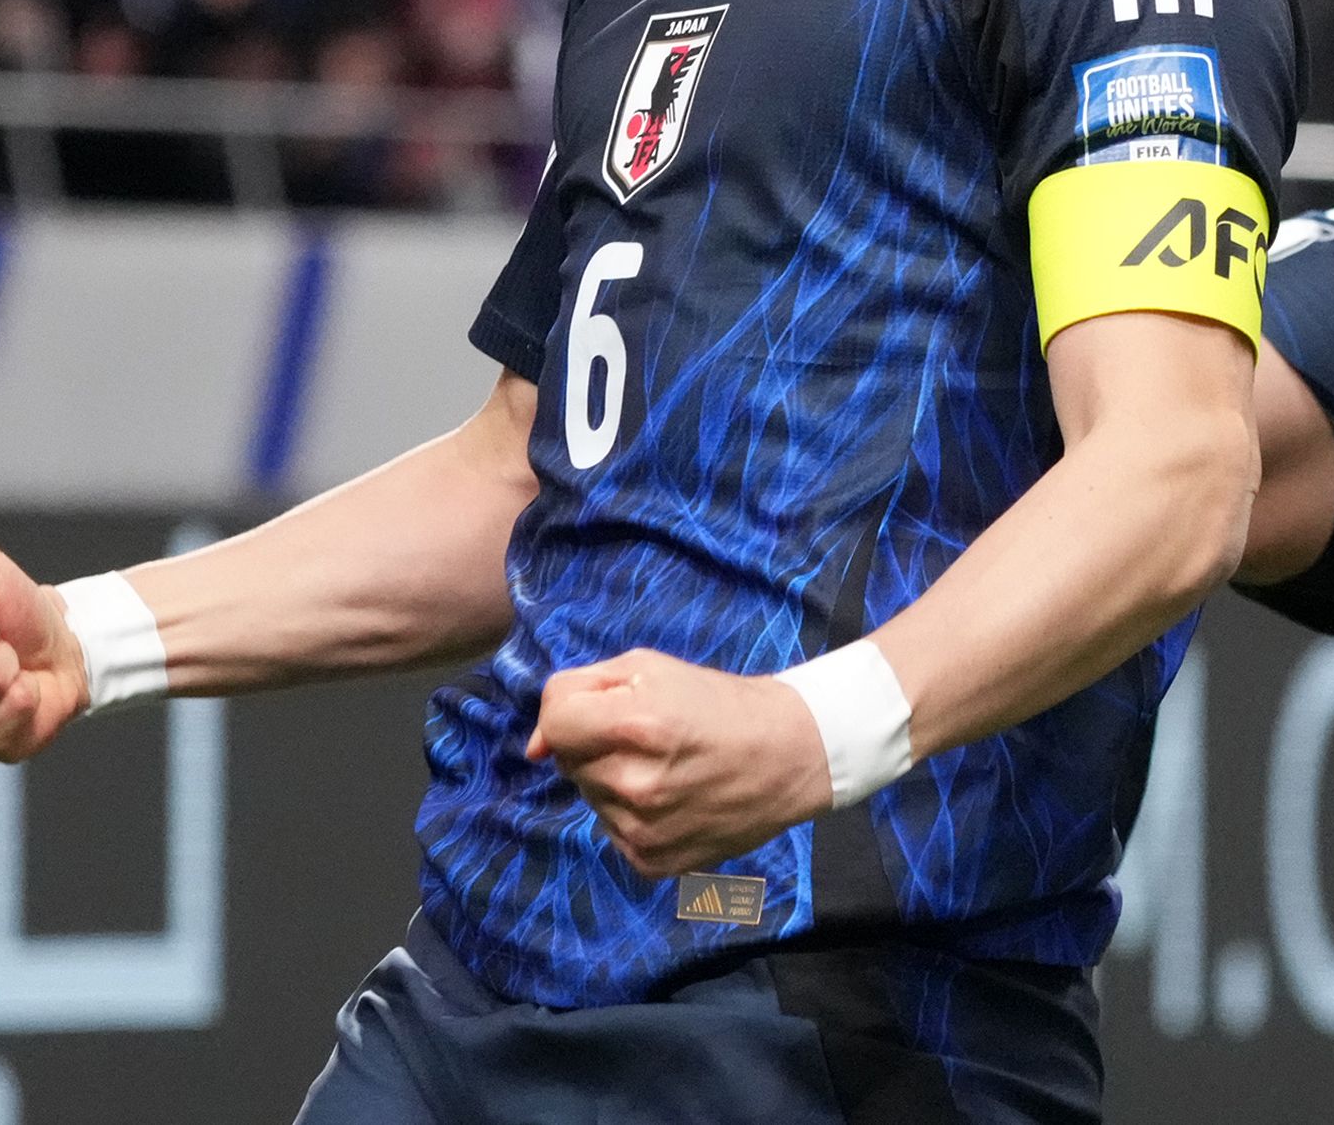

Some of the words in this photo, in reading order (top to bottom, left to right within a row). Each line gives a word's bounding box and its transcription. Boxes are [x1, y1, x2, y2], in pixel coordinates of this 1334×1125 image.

[664, 16, 709, 37] JAPAN
[1106, 72, 1193, 101] FOOTBALL
[1107, 94, 1195, 127] UNITES
[624, 139, 662, 169] JFA
[1136, 146, 1172, 159] FIFA
[565, 241, 644, 470] 6
